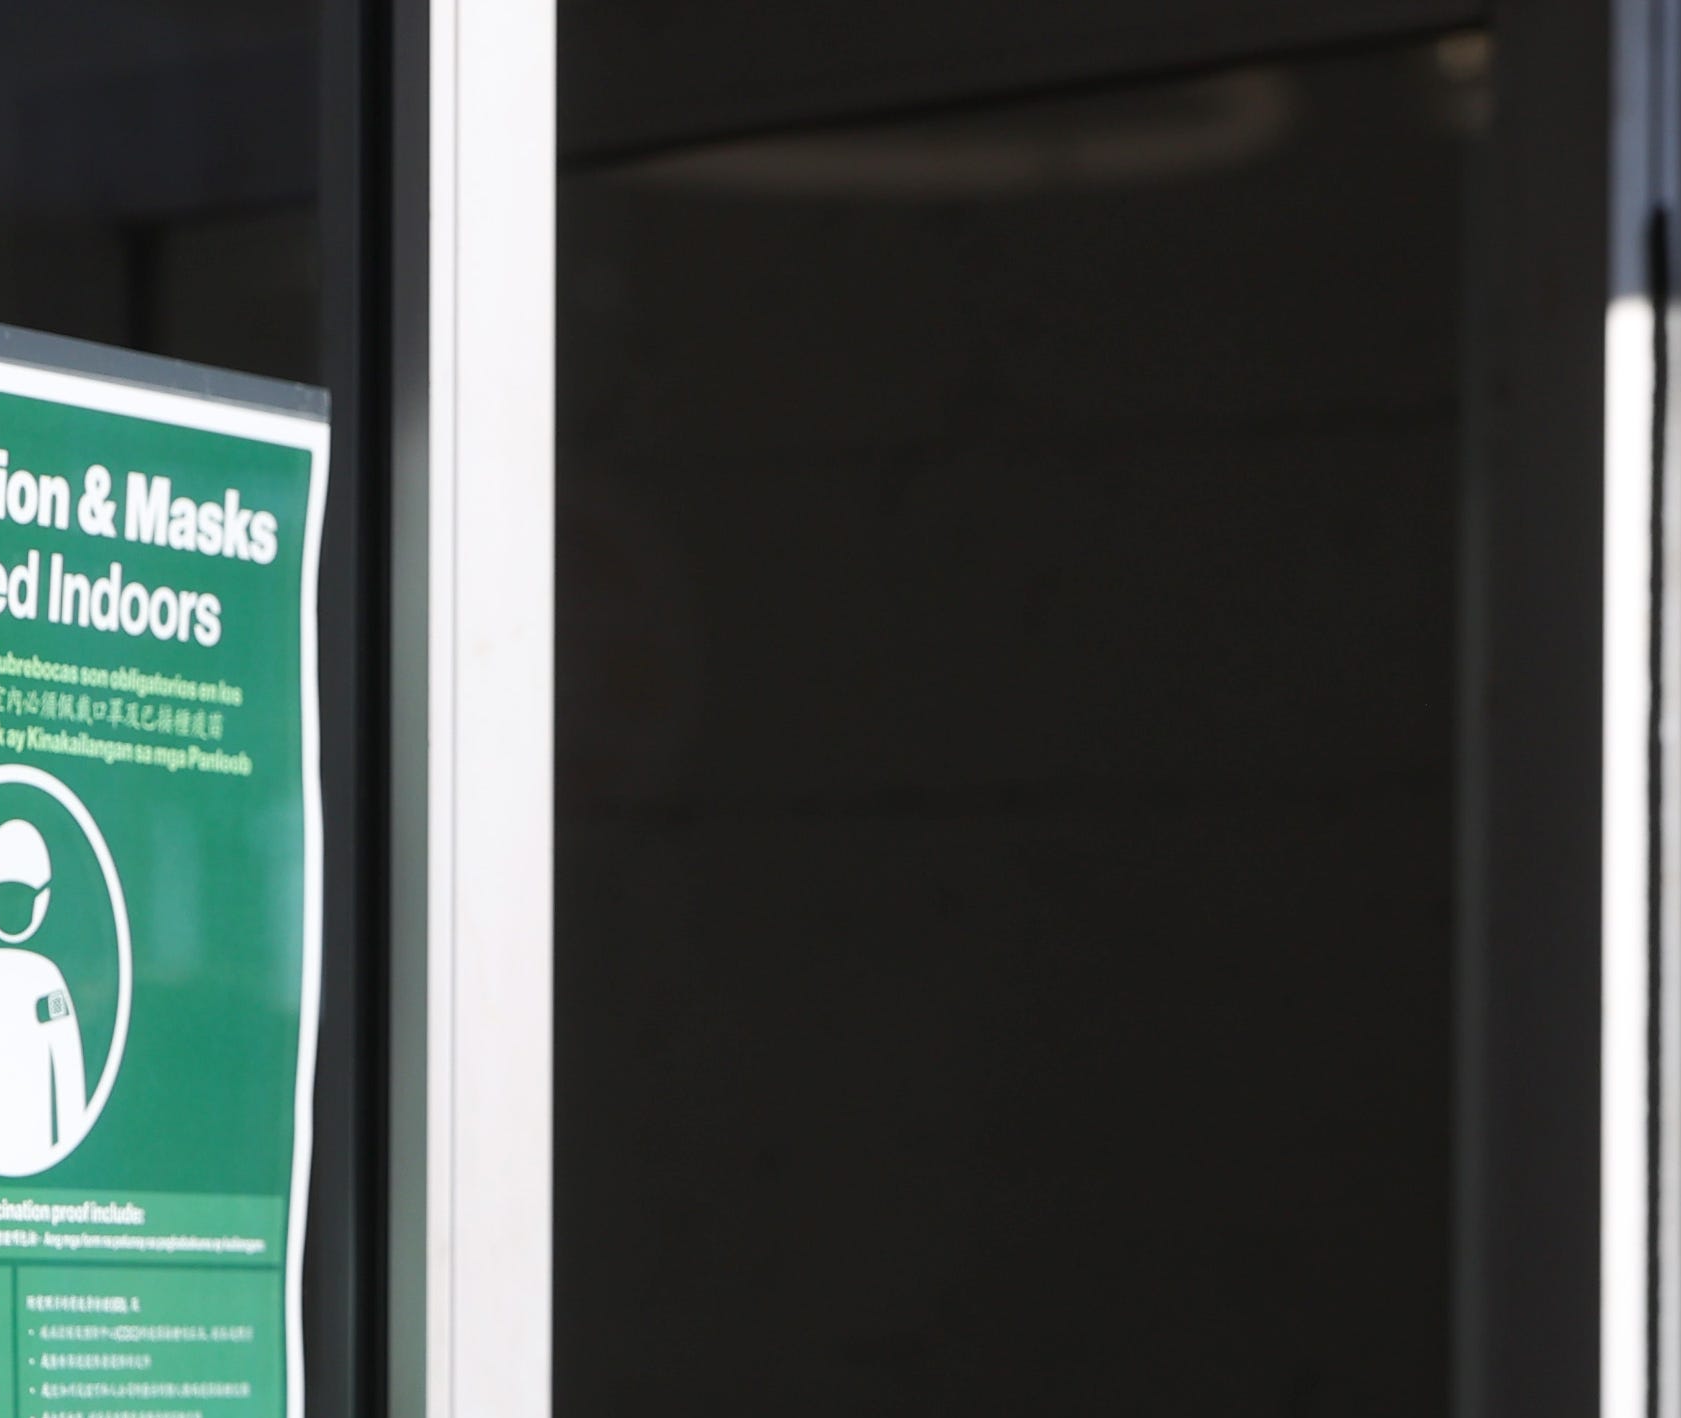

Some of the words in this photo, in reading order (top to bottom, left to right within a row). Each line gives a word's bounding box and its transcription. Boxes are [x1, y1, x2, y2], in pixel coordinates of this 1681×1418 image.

[78, 465, 116, 538] &
[124, 472, 277, 564] Masks
[49, 553, 221, 646] Indoors
